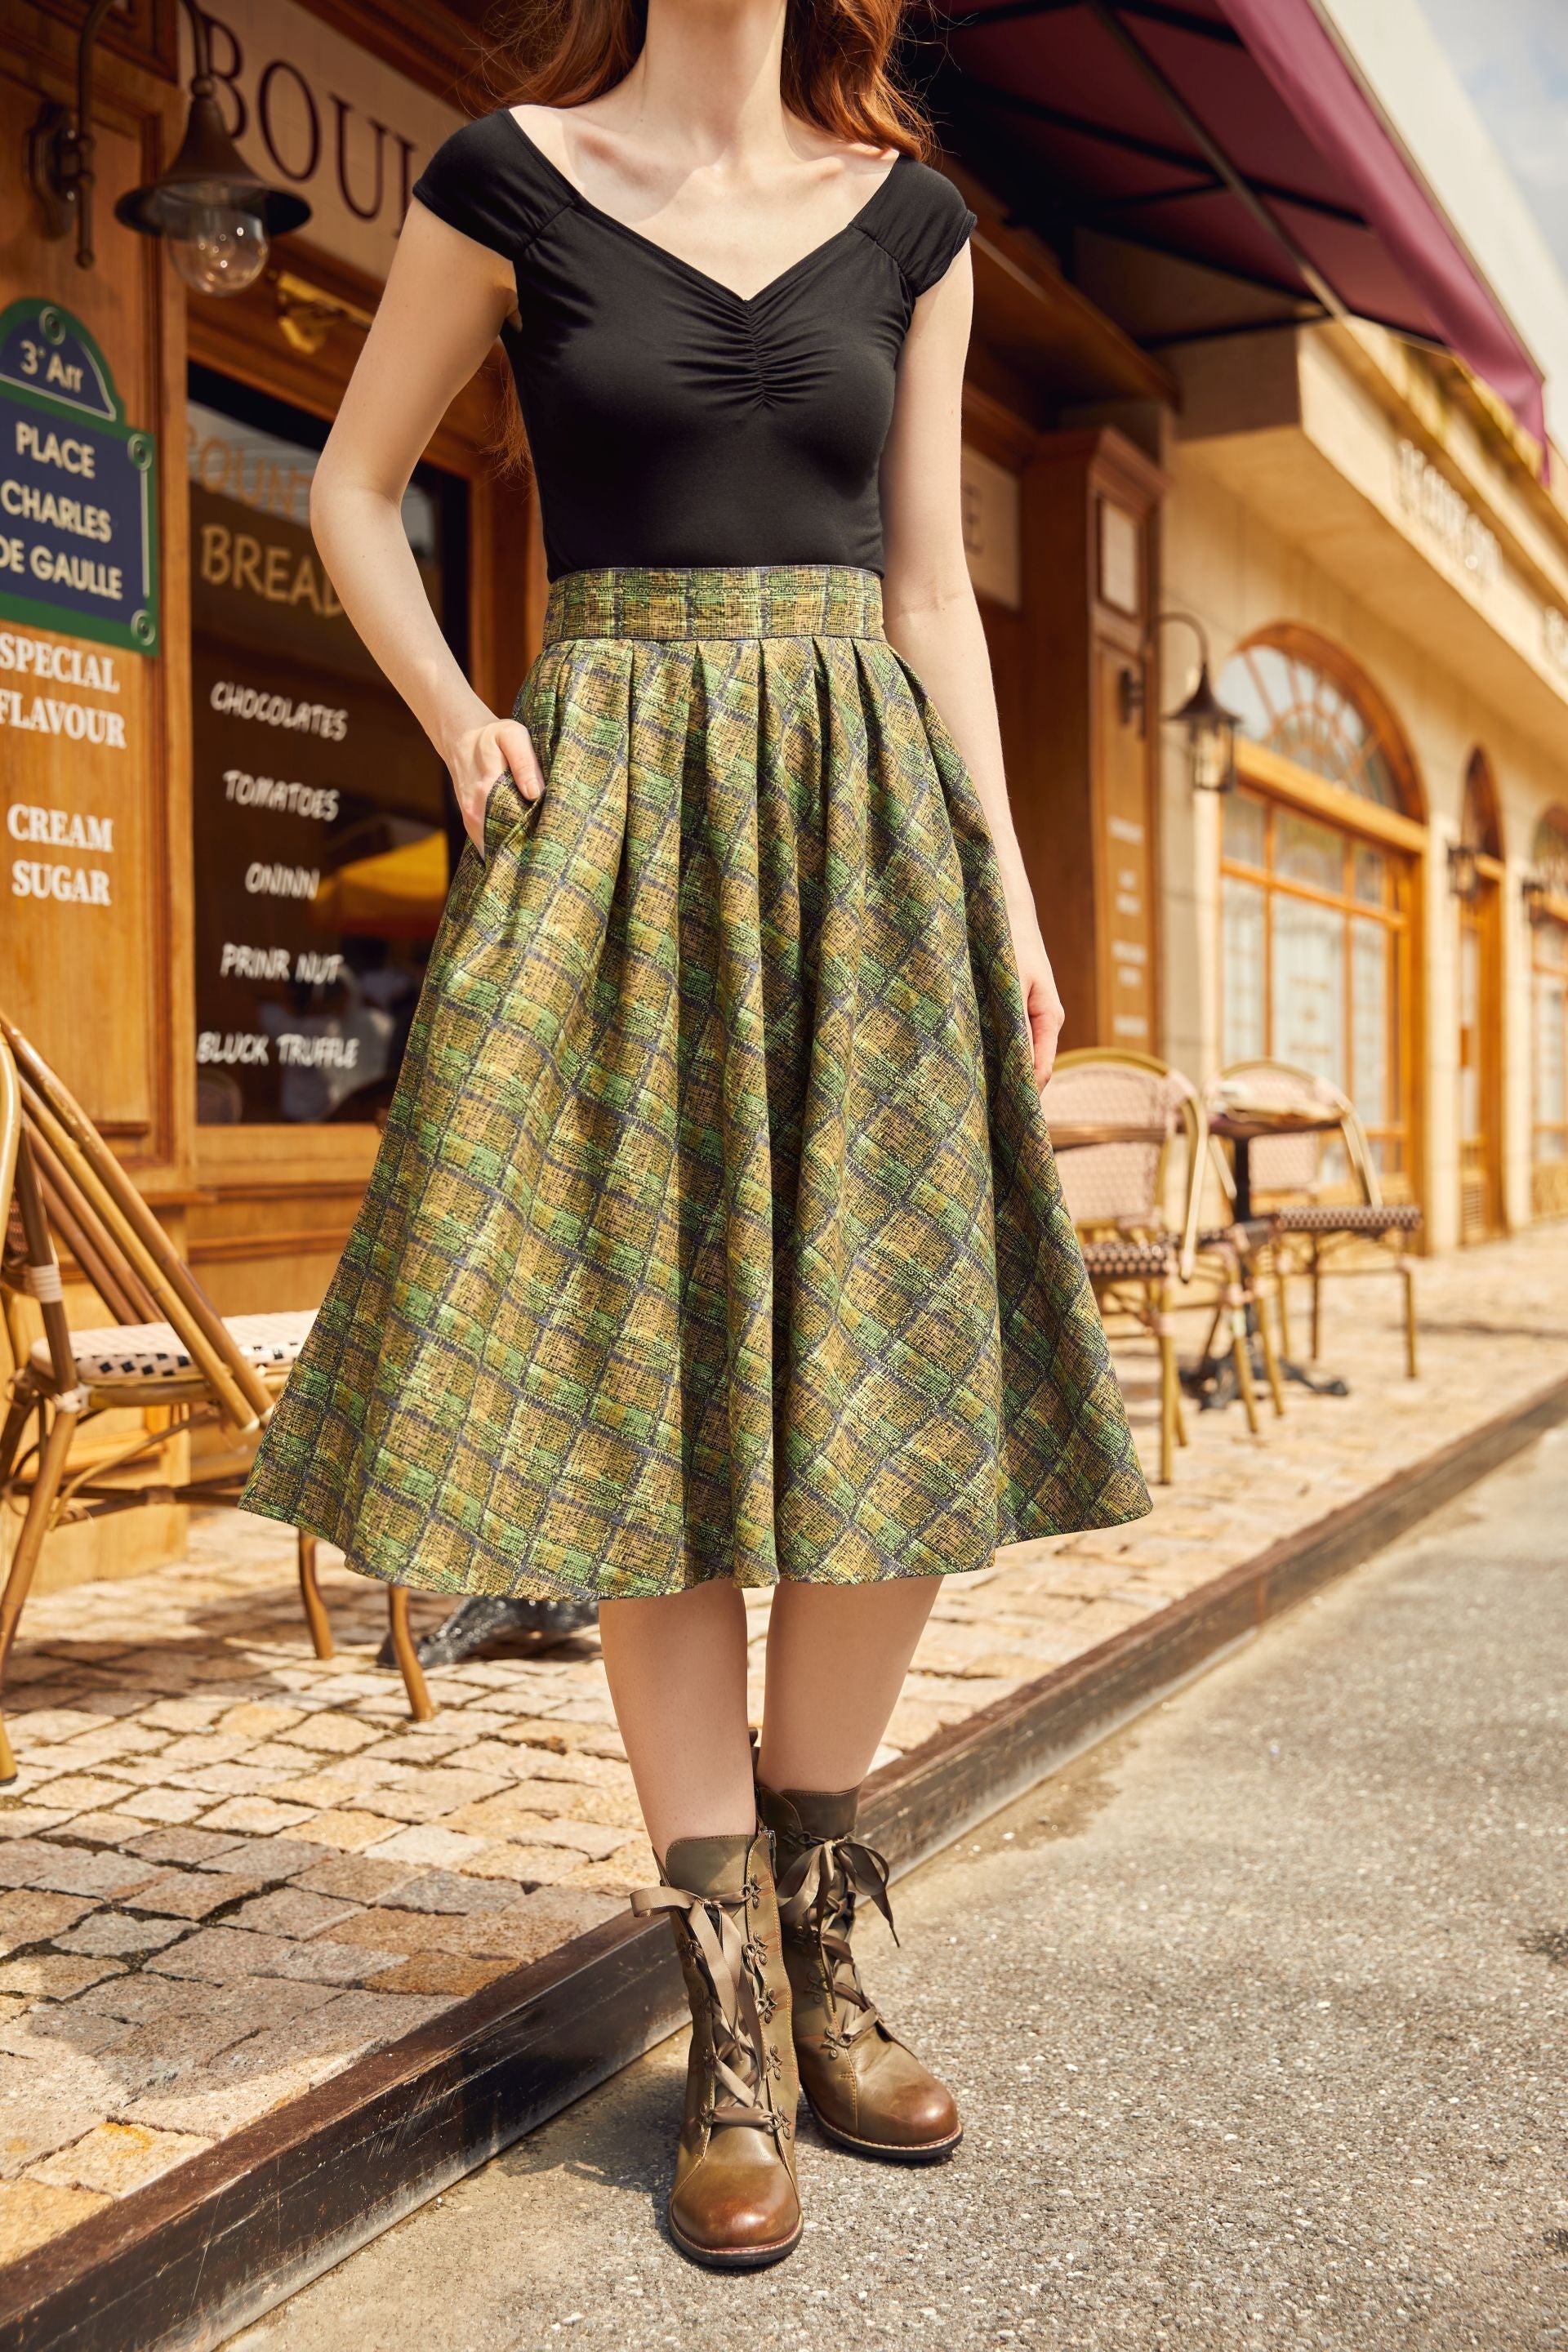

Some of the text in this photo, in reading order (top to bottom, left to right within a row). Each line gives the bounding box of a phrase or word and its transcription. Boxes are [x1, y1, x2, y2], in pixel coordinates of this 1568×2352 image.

[16, 421, 96, 479] PLACE
[187, 424, 314, 519] OUN
[0, 479, 112, 543] CHARLES
[29, 545, 122, 600] GAULLE
[0, 631, 120, 693] SPECIAL
[0, 688, 127, 750] FLAVOUR
[210, 681, 349, 742] CHOCOLATES
[222, 769, 340, 822] TOMATOES
[7, 803, 114, 853] CREAM
[11, 859, 112, 906] SUGAR
[295, 951, 344, 985] NUT
